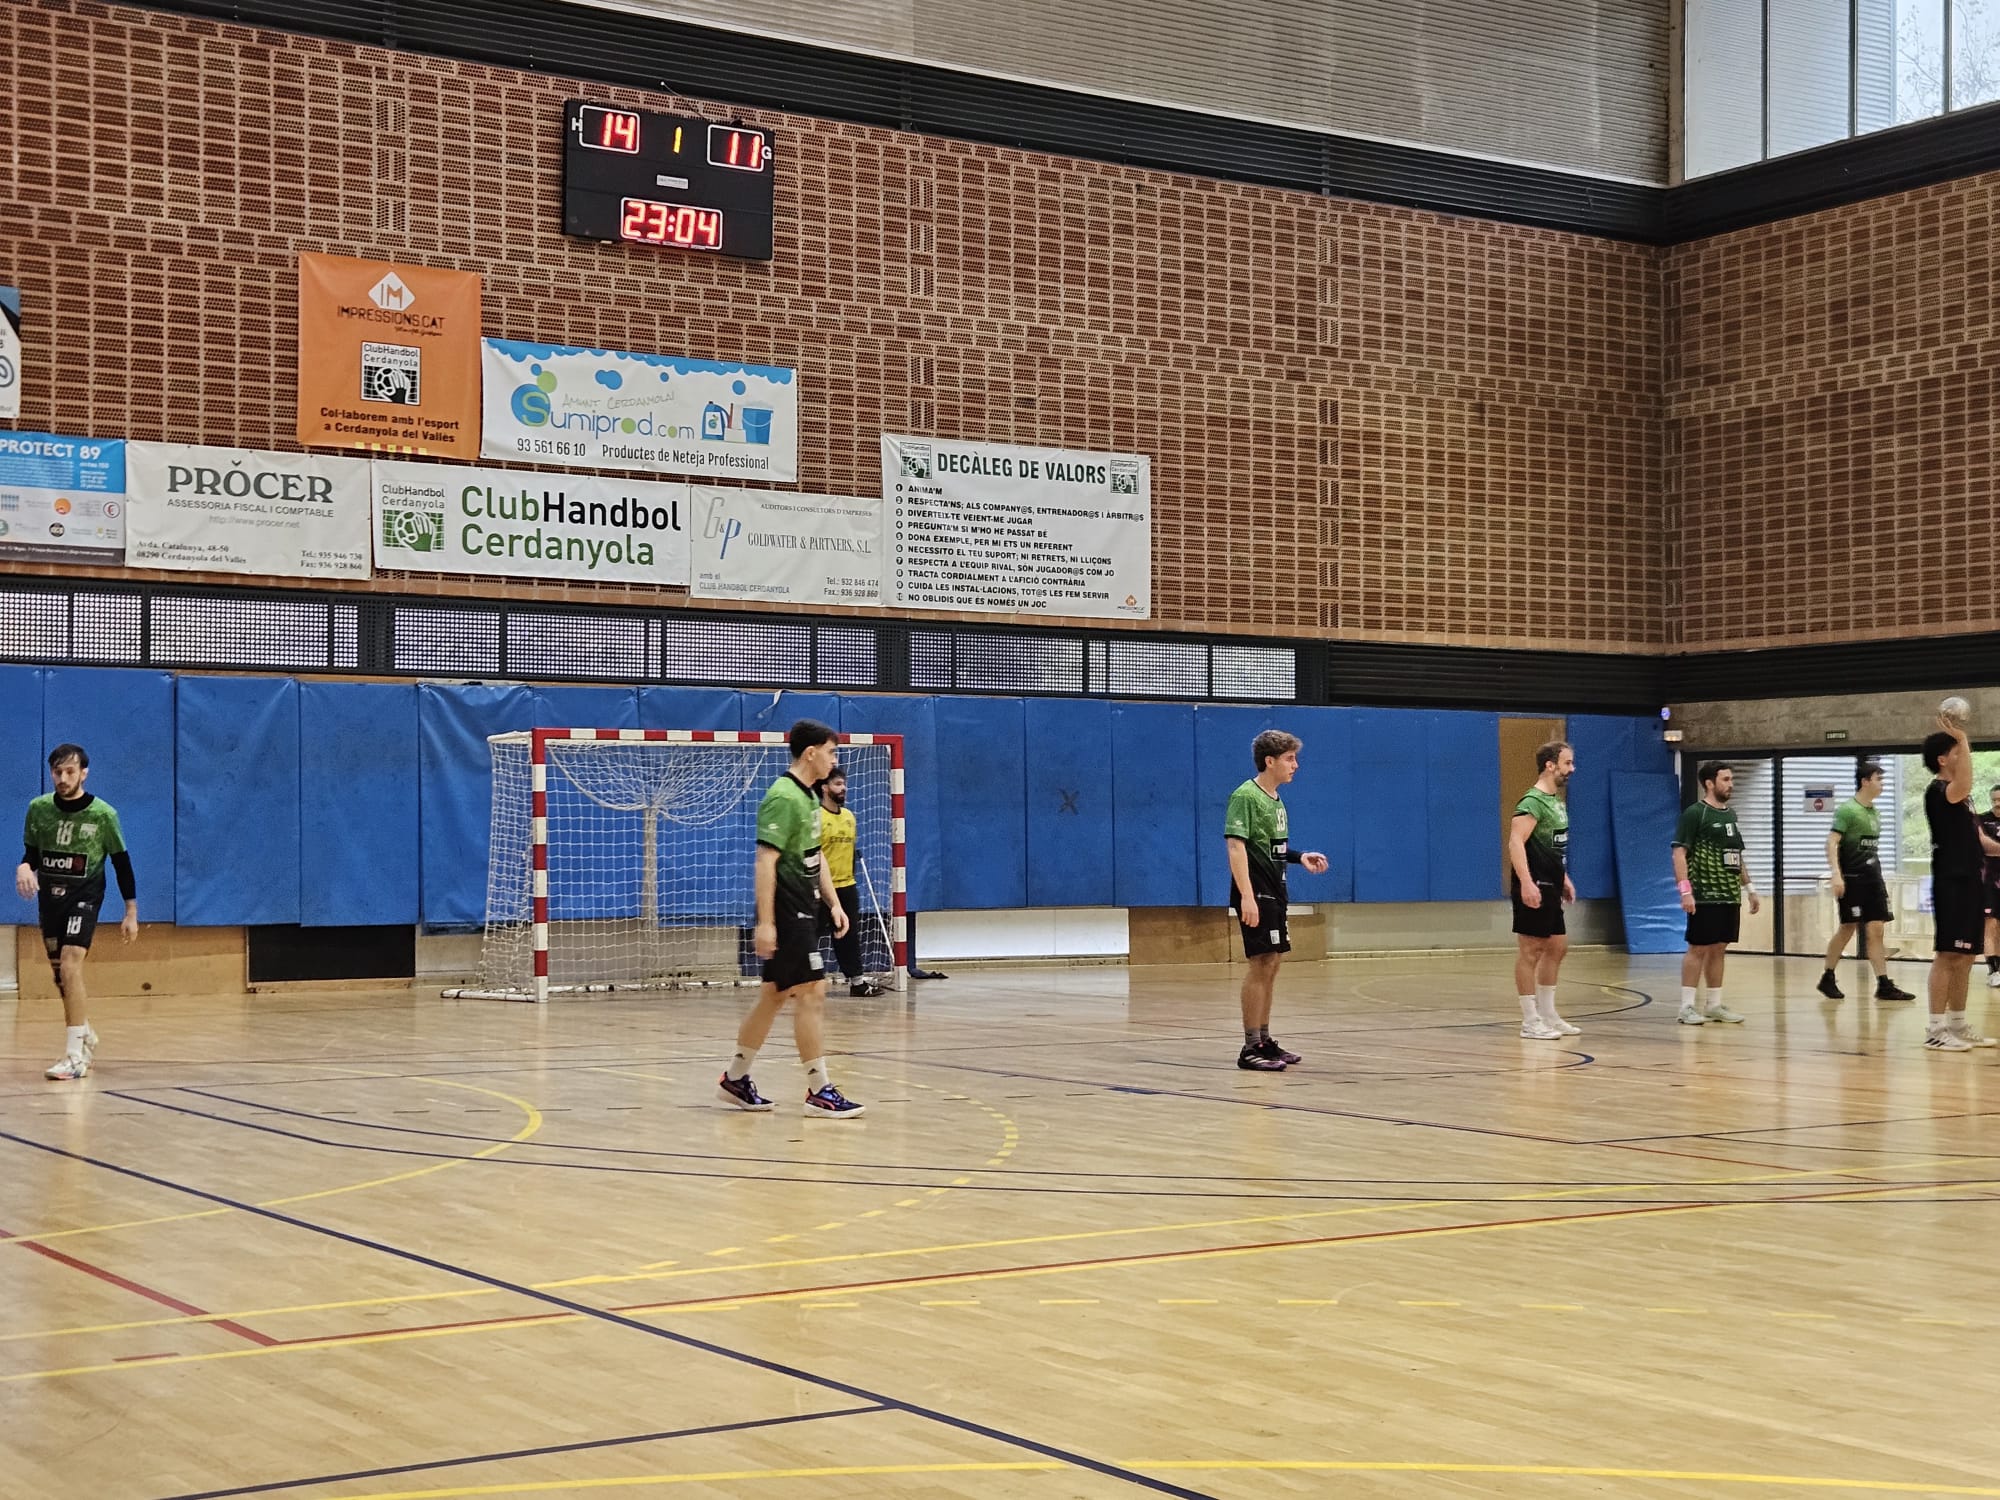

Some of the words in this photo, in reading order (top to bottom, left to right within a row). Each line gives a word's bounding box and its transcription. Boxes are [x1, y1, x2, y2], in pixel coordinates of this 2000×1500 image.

[572, 117, 582, 131] H
[602, 112, 636, 150] 14
[673, 126, 682, 154] 1
[729, 132, 760, 168] 11
[761, 146, 772, 160] G
[624, 202, 718, 245] 23:04
[364, 344, 418, 358] ClubHandbol
[364, 354, 418, 368] Cerdanyola
[335, 422, 398, 437] Cerdanyola
[402, 429, 418, 439] del
[392, 415, 414, 425] amb
[418, 417, 459, 430] l'esport
[0, 439, 74, 458] PROTECT
[80, 445, 101, 460] 89
[517, 438, 531, 452] 93
[534, 440, 552, 454] 561
[556, 442, 570, 455] 66
[574, 443, 586, 456] 10
[602, 444, 655, 461] Productes
[658, 448, 670, 462] de
[673, 450, 705, 465] Neteja
[708, 452, 769, 470] Professional
[938, 451, 1012, 477] DECÀLEG
[1019, 460, 1039, 479] DE
[1045, 462, 1106, 484] VALORS
[382, 484, 445, 497] ClubHandbol
[908, 485, 943, 495] ANIMA'M
[167, 499, 231, 510] ASSESSORIA
[234, 503, 267, 513] FISCAL
[276, 506, 334, 517] COMPTABLE
[382, 496, 445, 510] Cerdanyola
[462, 485, 681, 531] ClubHandbol
[797, 506, 836, 514] CONSULTORS
[983, 503, 1035, 514] COMPANY@S,
[1036, 507, 1099, 519] ENTRENADOR@S
[963, 514, 1005, 523] VEIENT-ME
[1007, 516, 1032, 525] JUGAR
[908, 522, 959, 532] PREGUNTA'M
[971, 526, 992, 535] M'HO
[1007, 528, 1035, 537] PASSAT
[462, 523, 654, 569] Cerdanyola
[748, 532, 797, 549] GOLDWATER
[800, 536, 806, 549] &
[908, 533, 931, 542] DONA
[934, 535, 972, 546] EXEMPLE,
[1034, 542, 1073, 551] REFERENT
[162, 552, 208, 562] Cerdanyola
[908, 546, 954, 556] NECESSITO
[968, 550, 983, 558] TEU
[985, 551, 1018, 560] SUPORT;
[1032, 554, 1068, 564] RETRETS,
[1080, 556, 1111, 566] LLIÇONS
[908, 558, 948, 567] RESPECTA
[960, 561, 989, 569] L'EQUIP
[992, 563, 1015, 572] RIVAL,
[1036, 567, 1084, 576] JUGADOR@S
[868, 579, 879, 587] 474
[908, 570, 938, 578] TRACTA
[941, 571, 999, 582] CORDIALMENT
[750, 585, 790, 593] CERDANYOLA
[908, 582, 933, 590] CUIDA
[1022, 588, 1047, 597] TOT@S
[1082, 591, 1109, 600] SERVIR
[922, 595, 954, 603] OBLIDIS
[956, 596, 972, 605] QUE
[987, 597, 1015, 606] NOMÉS
[56, 820, 73, 845] 18
[67, 915, 82, 935] 18
